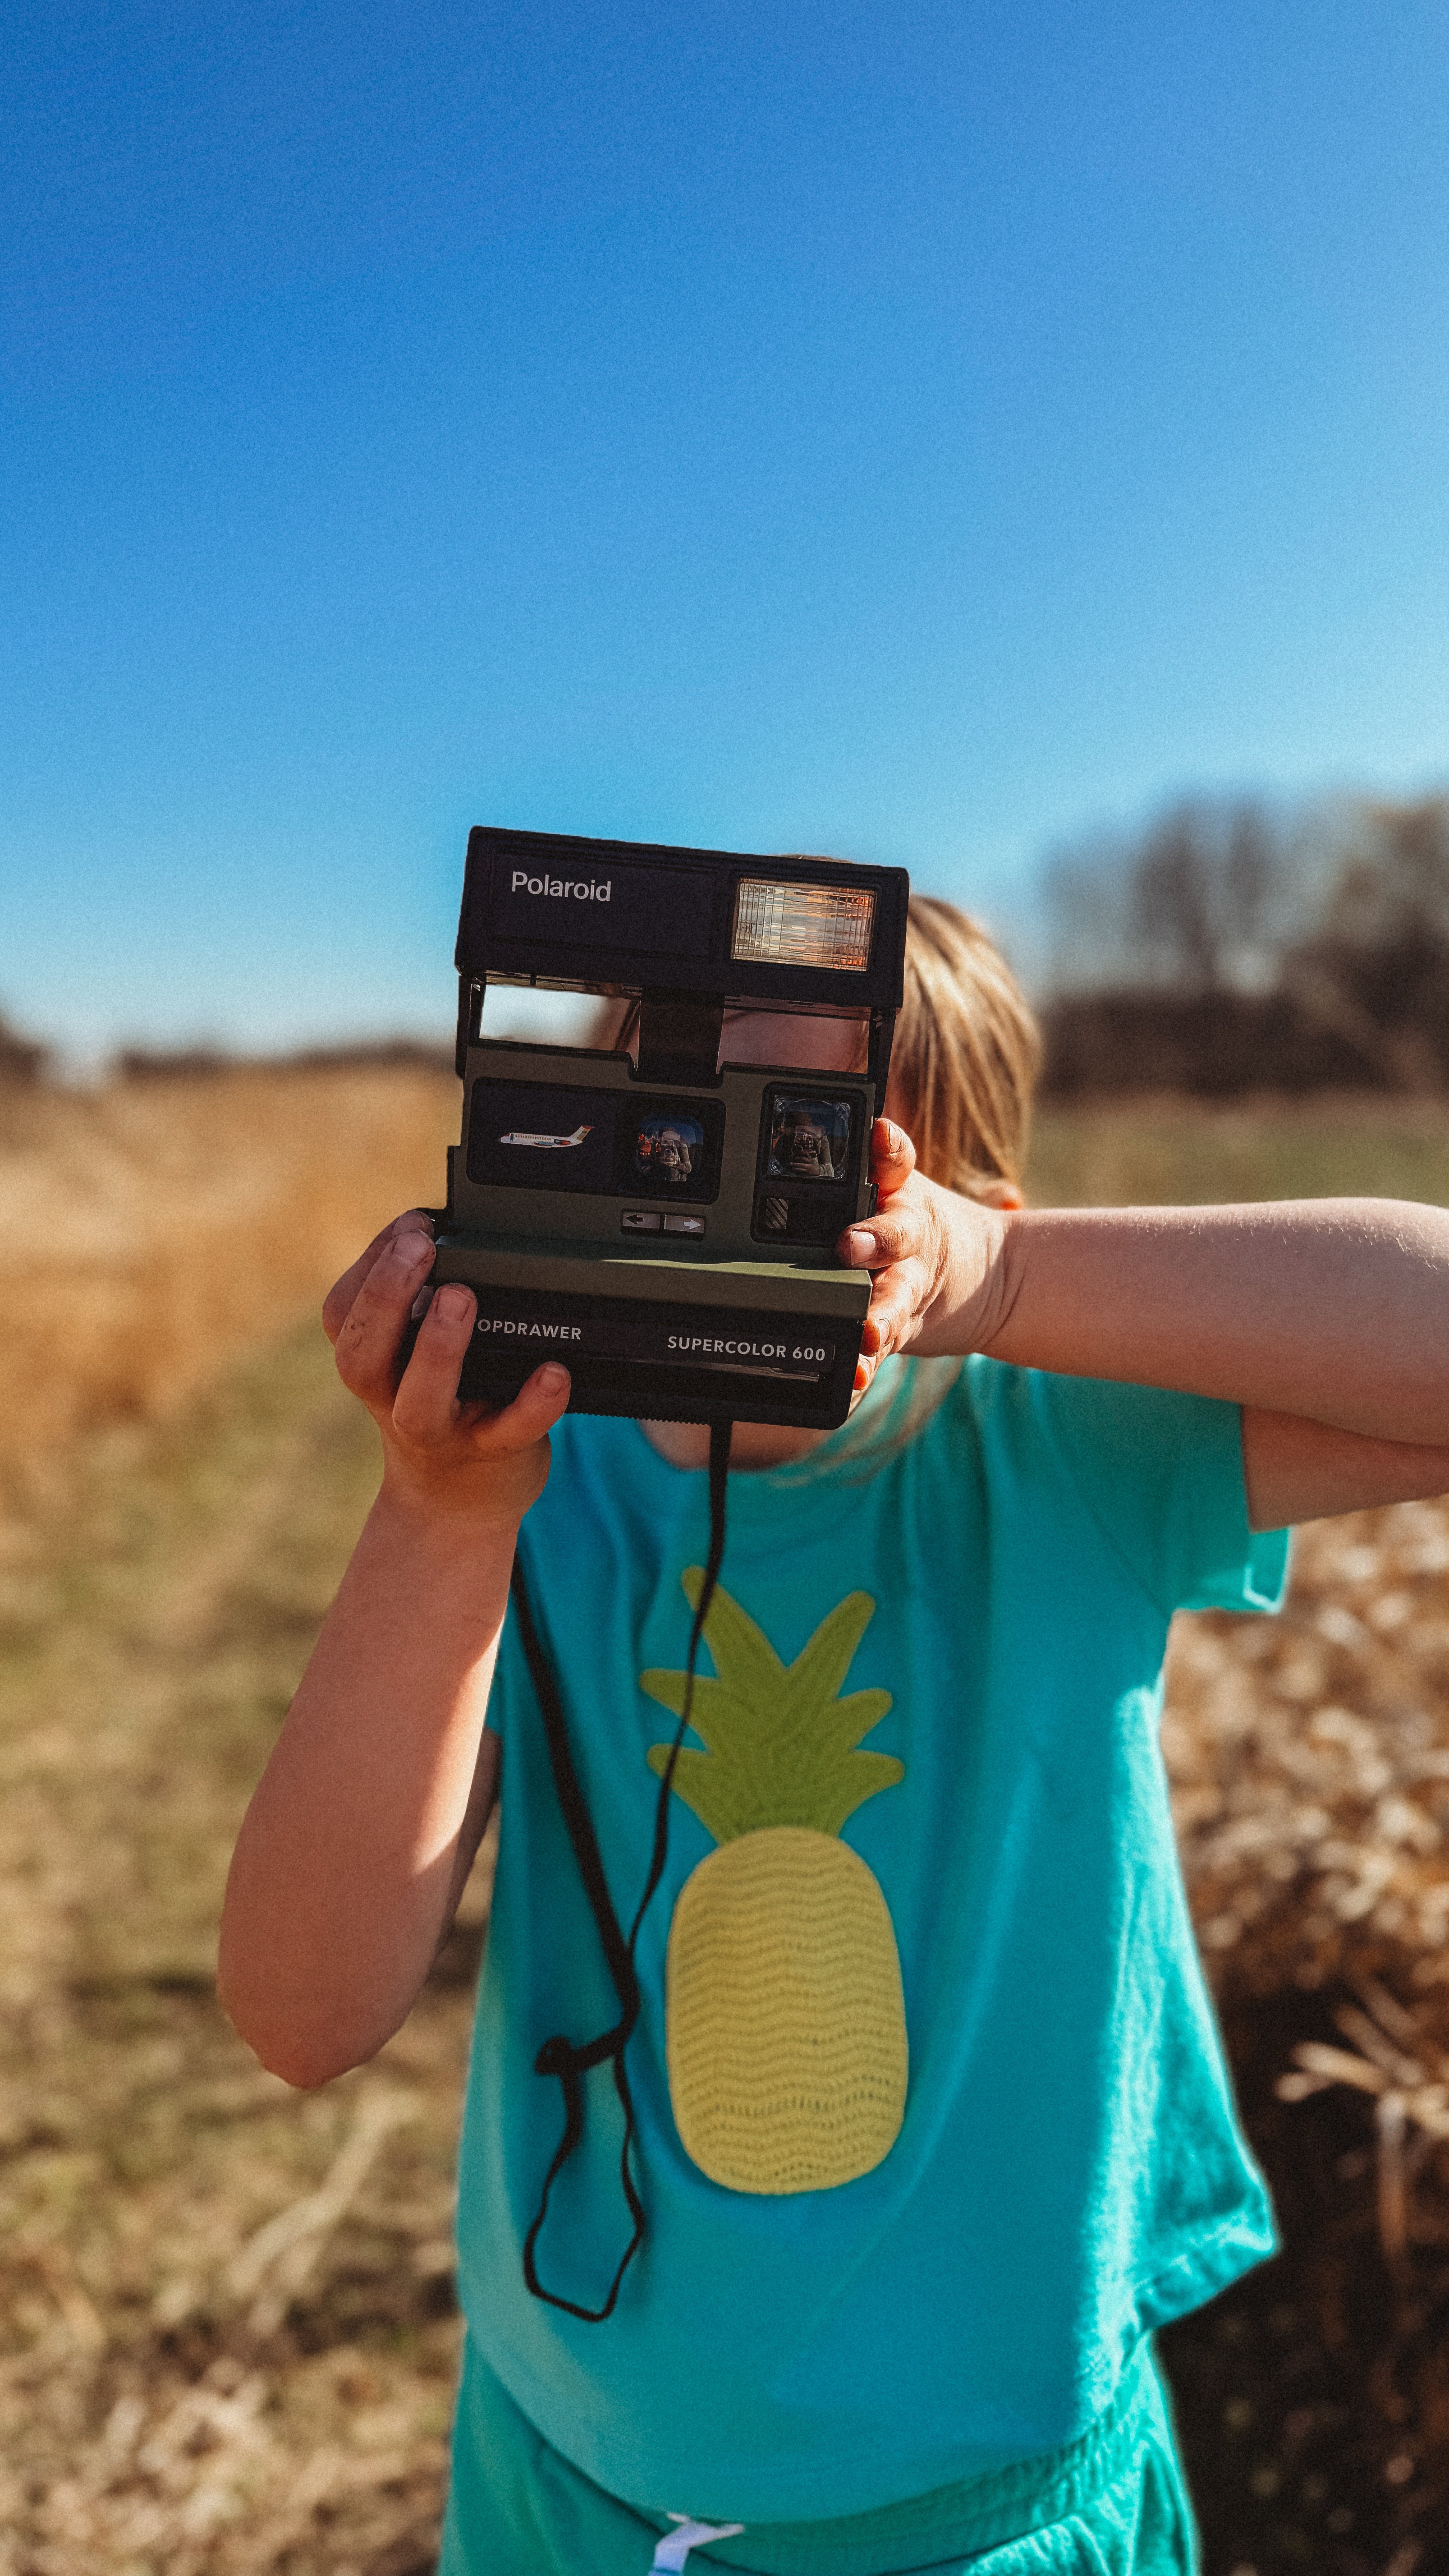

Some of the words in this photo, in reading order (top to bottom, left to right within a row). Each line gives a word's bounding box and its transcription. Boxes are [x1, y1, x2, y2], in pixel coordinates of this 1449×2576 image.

[512, 871, 611, 902] Polaroid
[475, 1319, 582, 1340] OPDRAWER
[668, 1336, 786, 1357] SUPERCOLOR
[793, 1347, 825, 1361] 600
